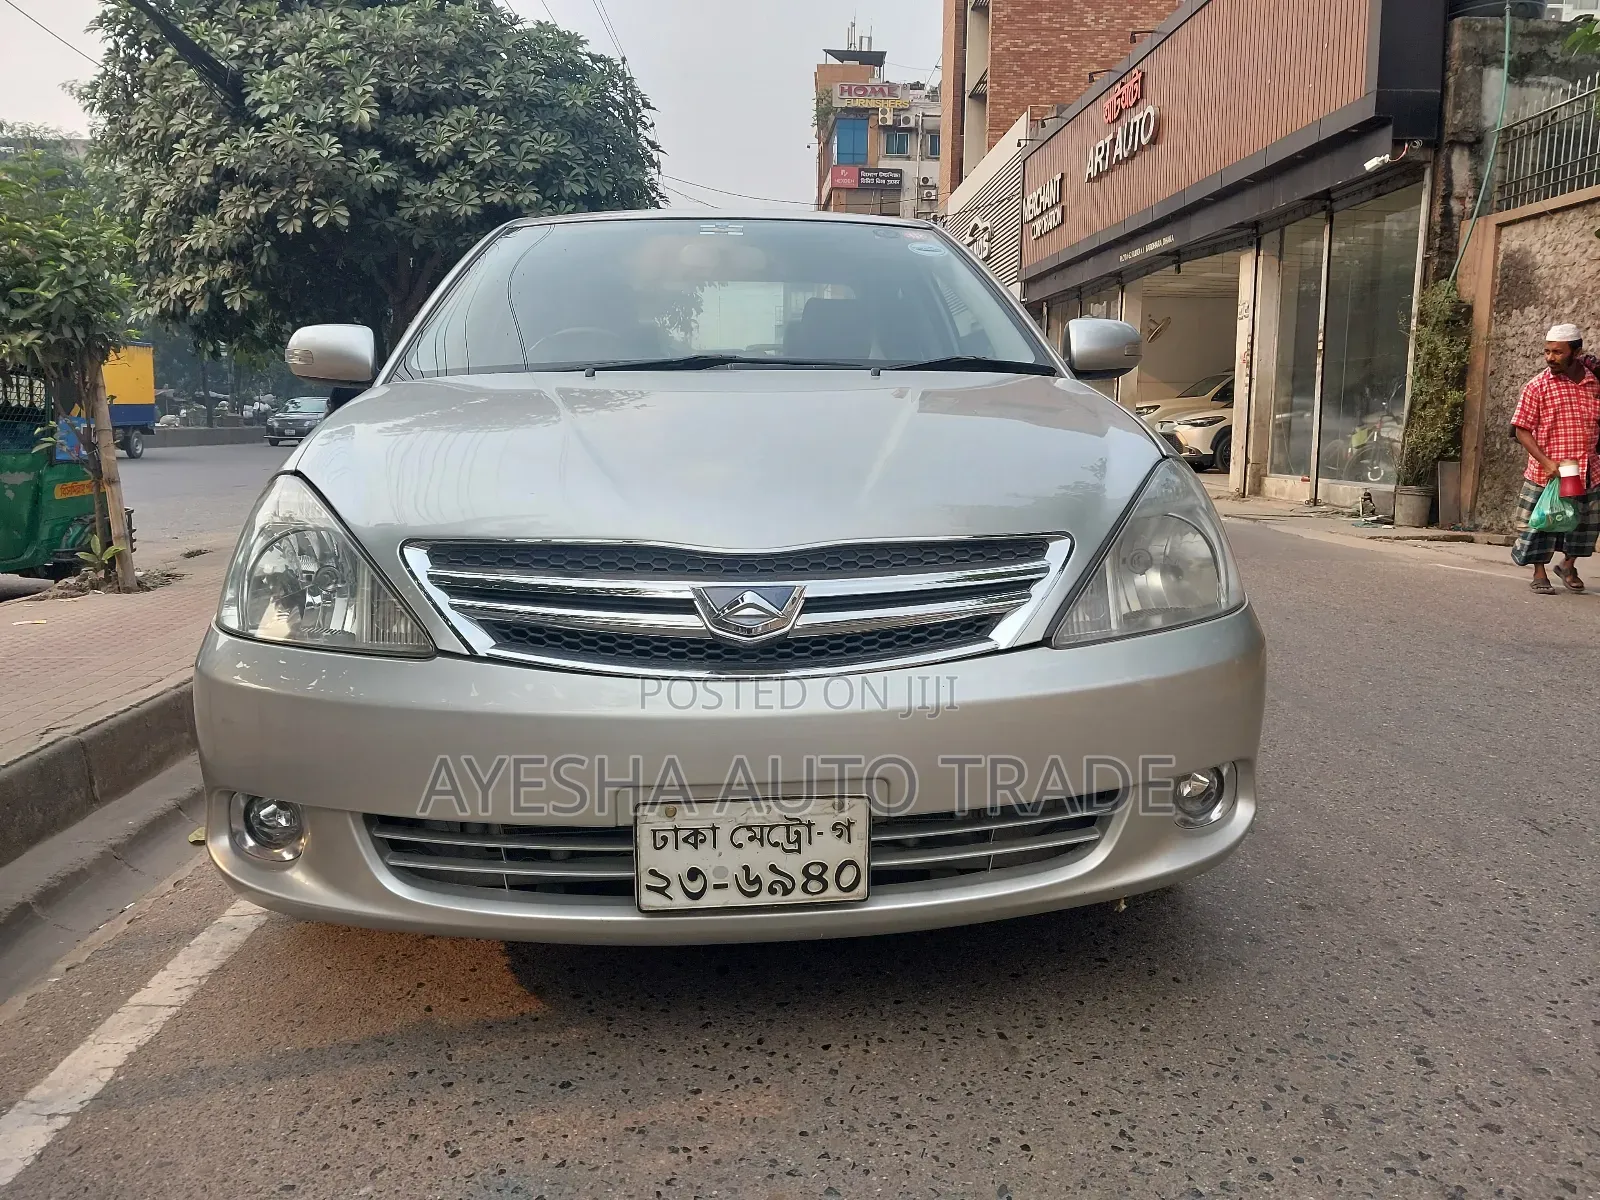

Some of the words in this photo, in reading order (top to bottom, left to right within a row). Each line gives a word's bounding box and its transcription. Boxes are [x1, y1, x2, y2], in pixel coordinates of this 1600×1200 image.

[840, 85, 899, 97] HOME
[845, 99, 910, 108] FURNISHERS
[1085, 132, 1114, 184] ART
[1112, 105, 1158, 165] AUTO
[1022, 172, 1062, 225] MERCHANT
[1031, 204, 1063, 241] CORPORATION
[651, 823, 721, 850] ঢাকা
[645, 858, 862, 901] ২৩-৬৯৪০
